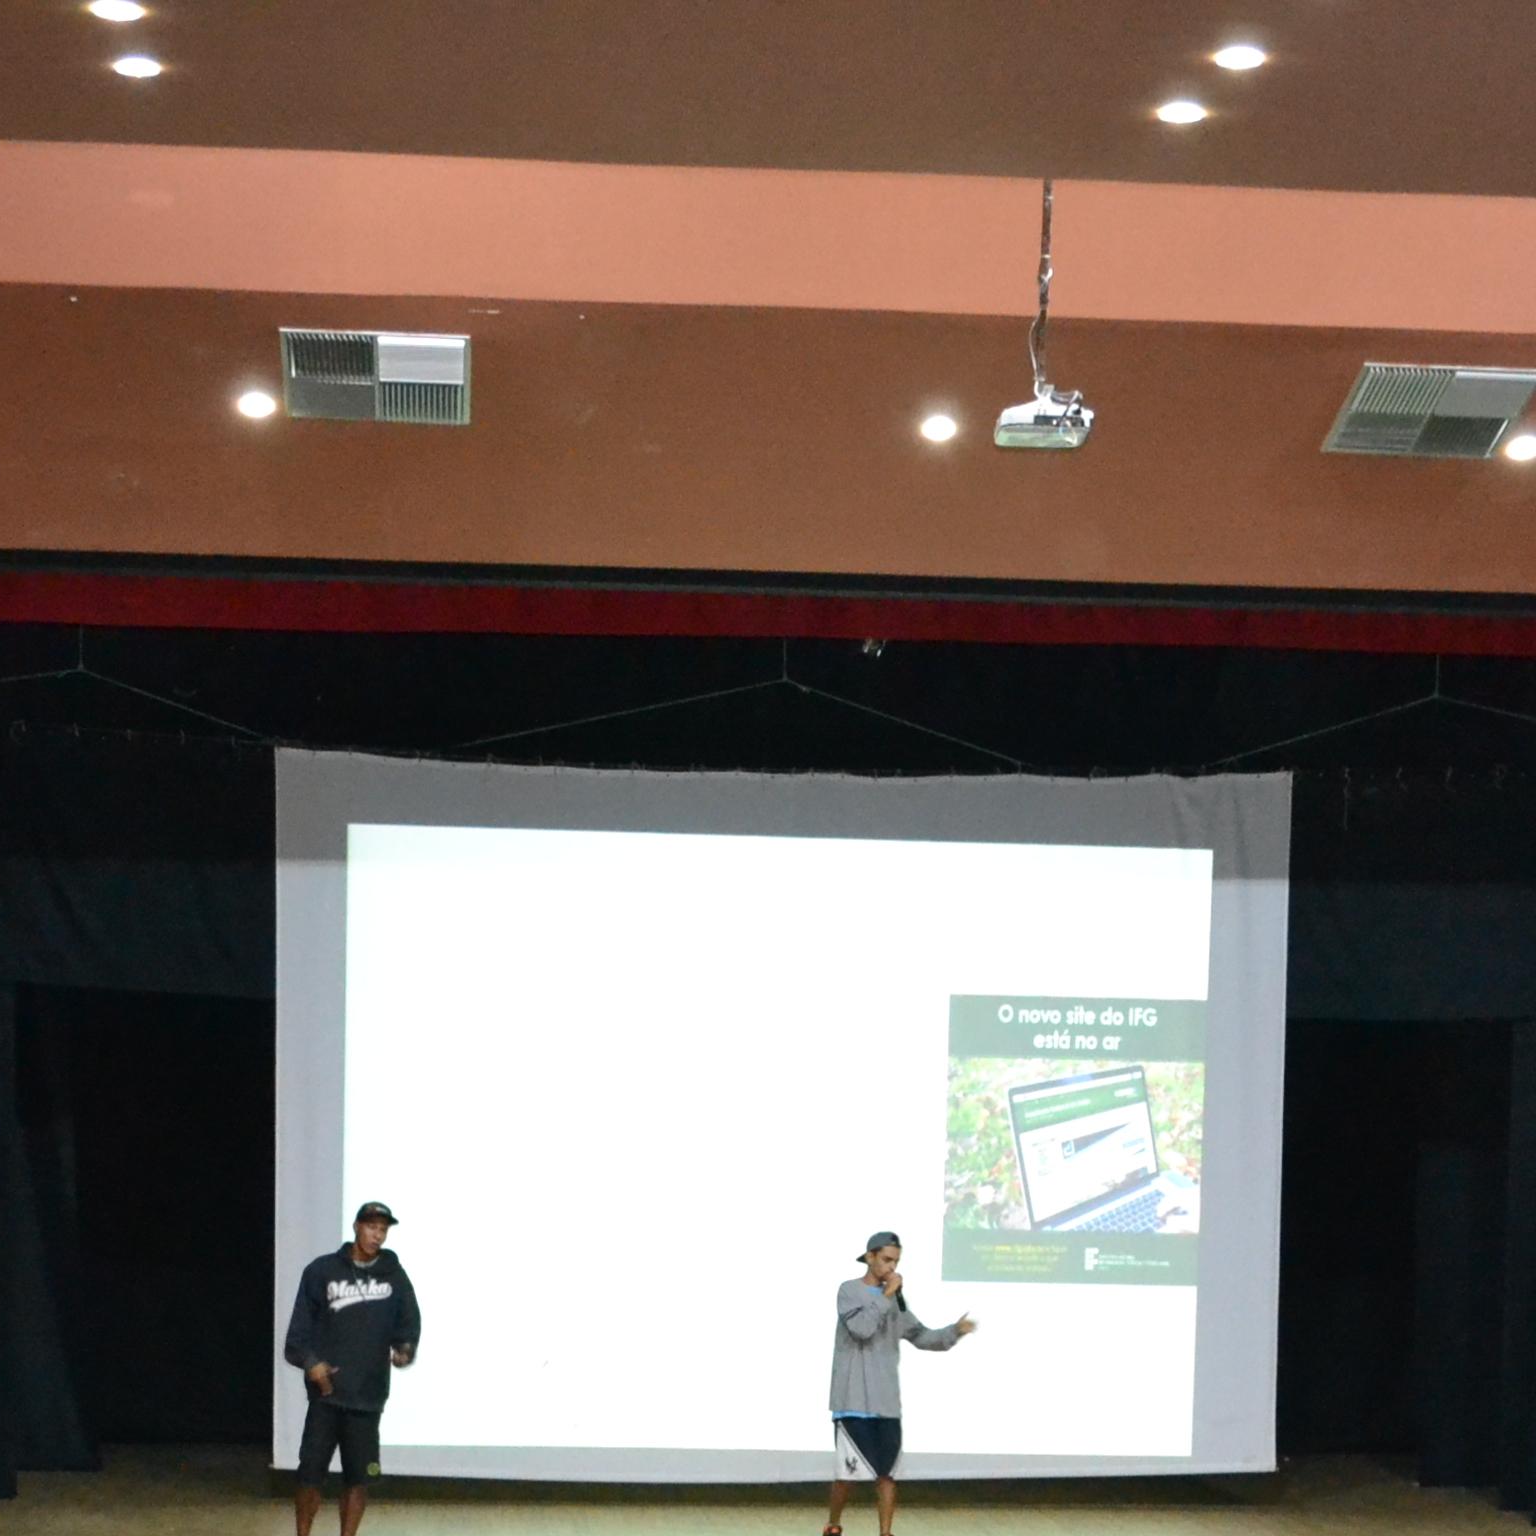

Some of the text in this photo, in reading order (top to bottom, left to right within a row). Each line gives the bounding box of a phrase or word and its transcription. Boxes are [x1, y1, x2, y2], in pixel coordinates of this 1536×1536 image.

[998, 1003, 1158, 1027] O novo site do IFG
[1033, 1029, 1122, 1051] está no ar
